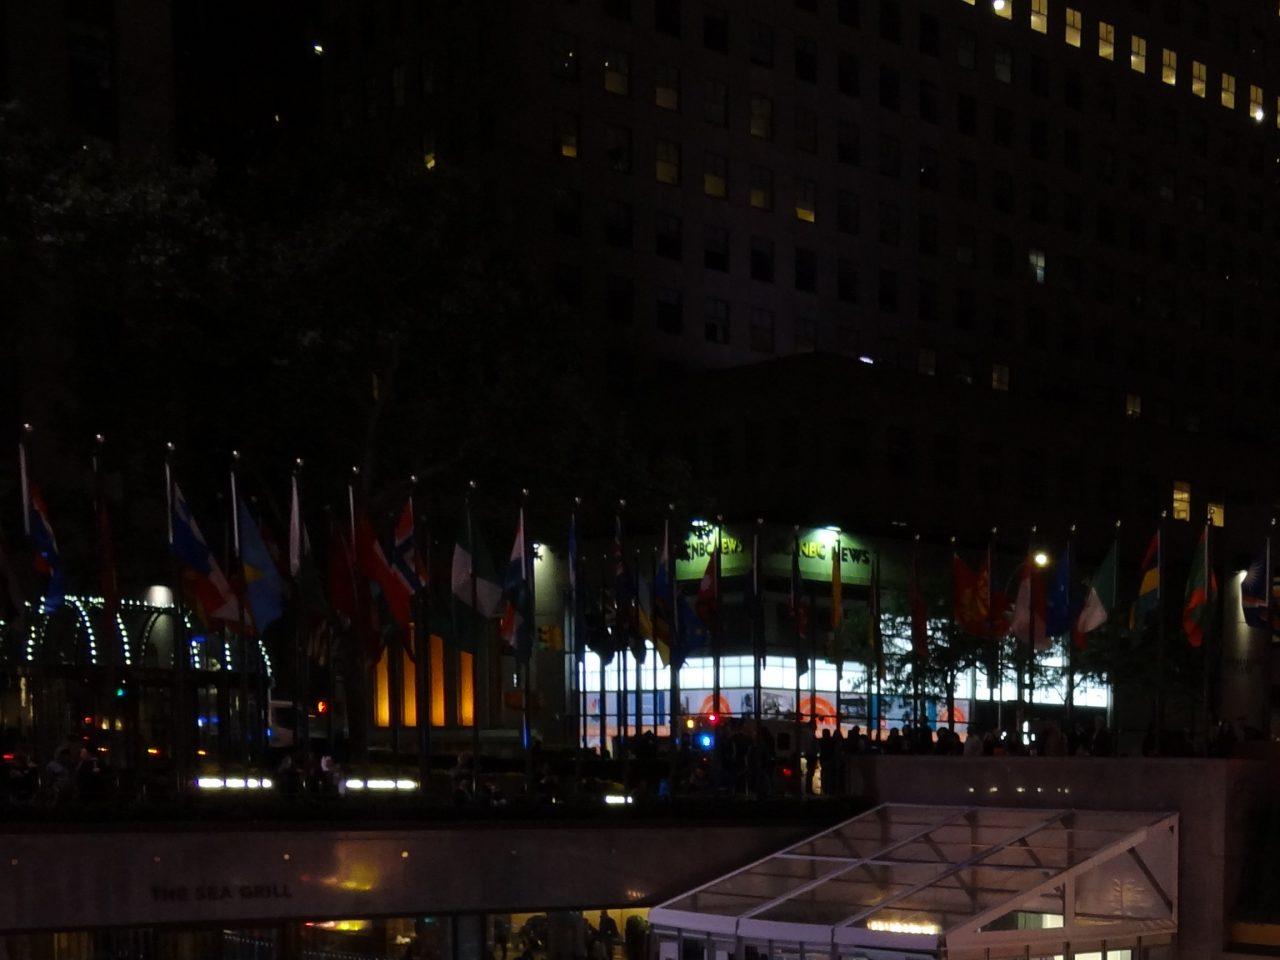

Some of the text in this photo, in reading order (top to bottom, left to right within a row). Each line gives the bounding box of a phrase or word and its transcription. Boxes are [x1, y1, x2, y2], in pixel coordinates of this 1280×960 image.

[800, 541, 826, 560] NBC
[151, 883, 292, 901] THE SEA GRILL
